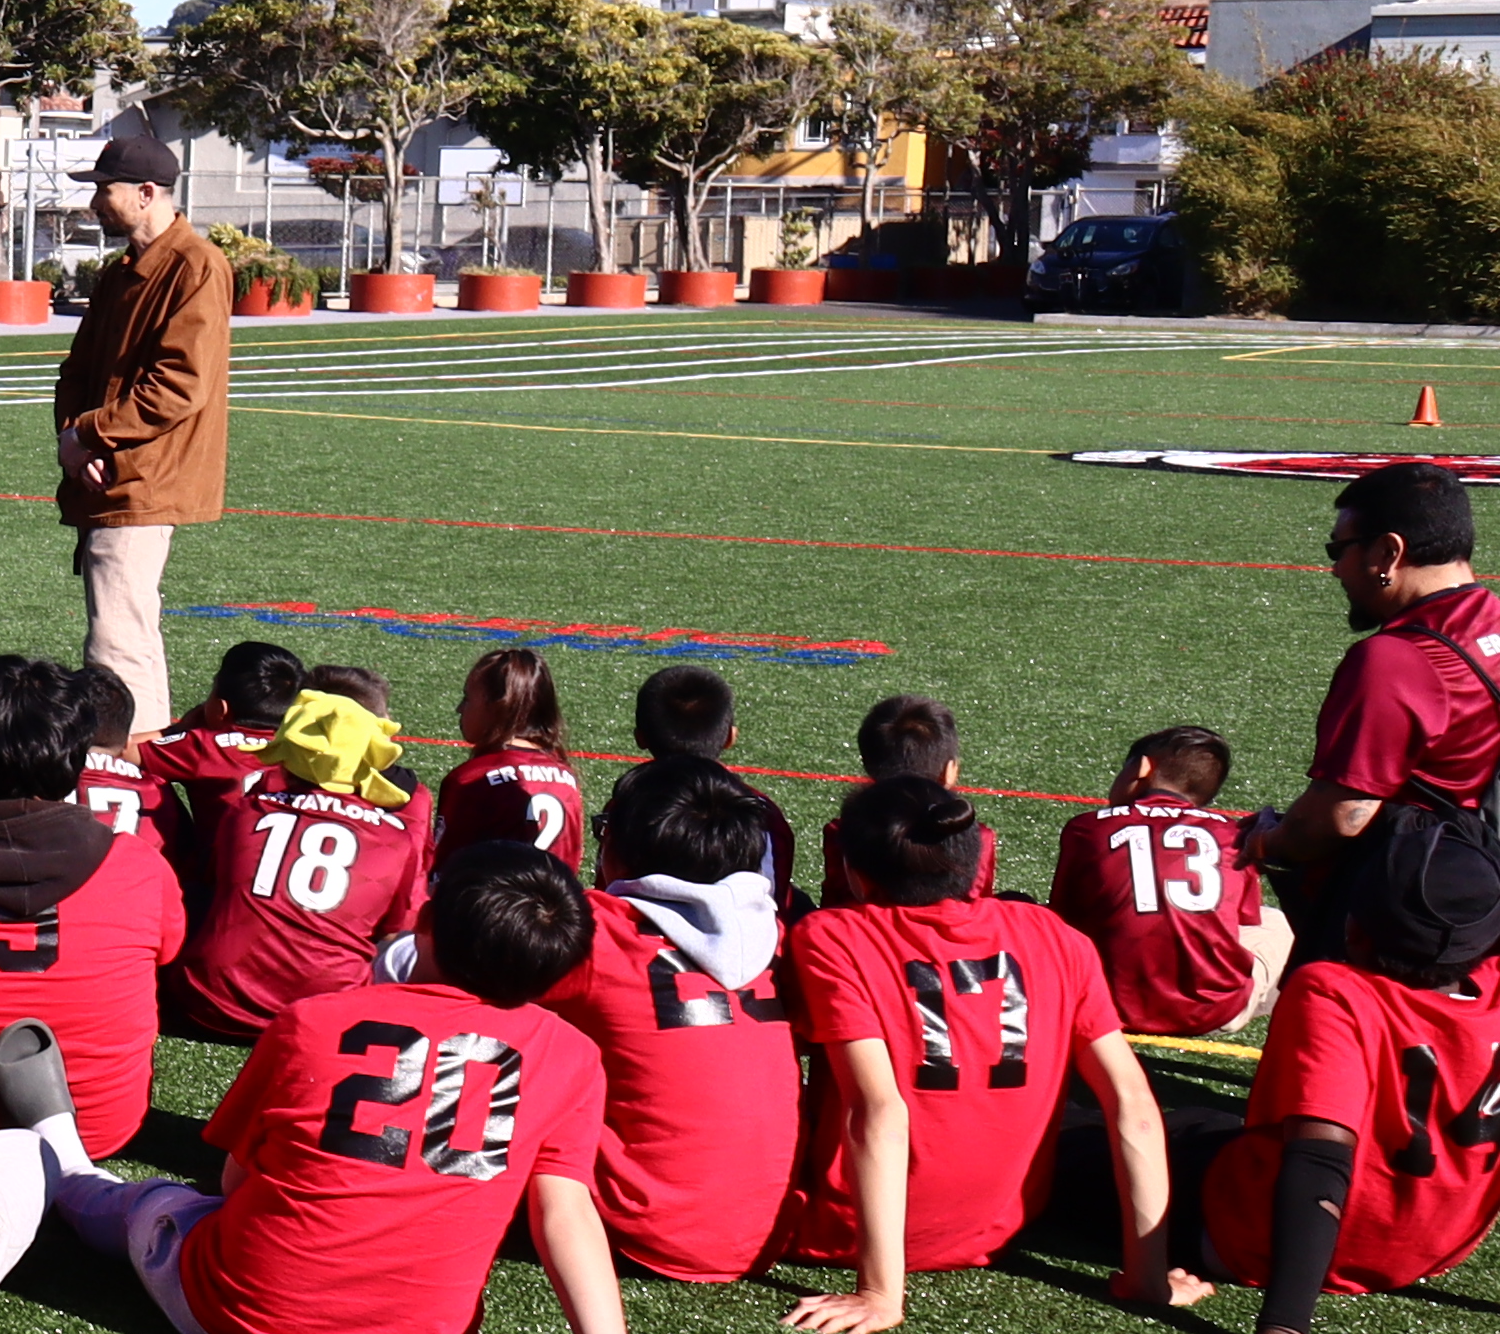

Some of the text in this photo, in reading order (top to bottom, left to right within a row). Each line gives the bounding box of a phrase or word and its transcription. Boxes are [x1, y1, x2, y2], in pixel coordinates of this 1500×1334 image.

[215, 732, 246, 748] ER
[486, 765, 578, 789] ER TAYLO
[252, 812, 359, 914] 18
[1110, 824, 1222, 913] 13
[905, 950, 1029, 1090] 17
[319, 1020, 523, 1180] 20
